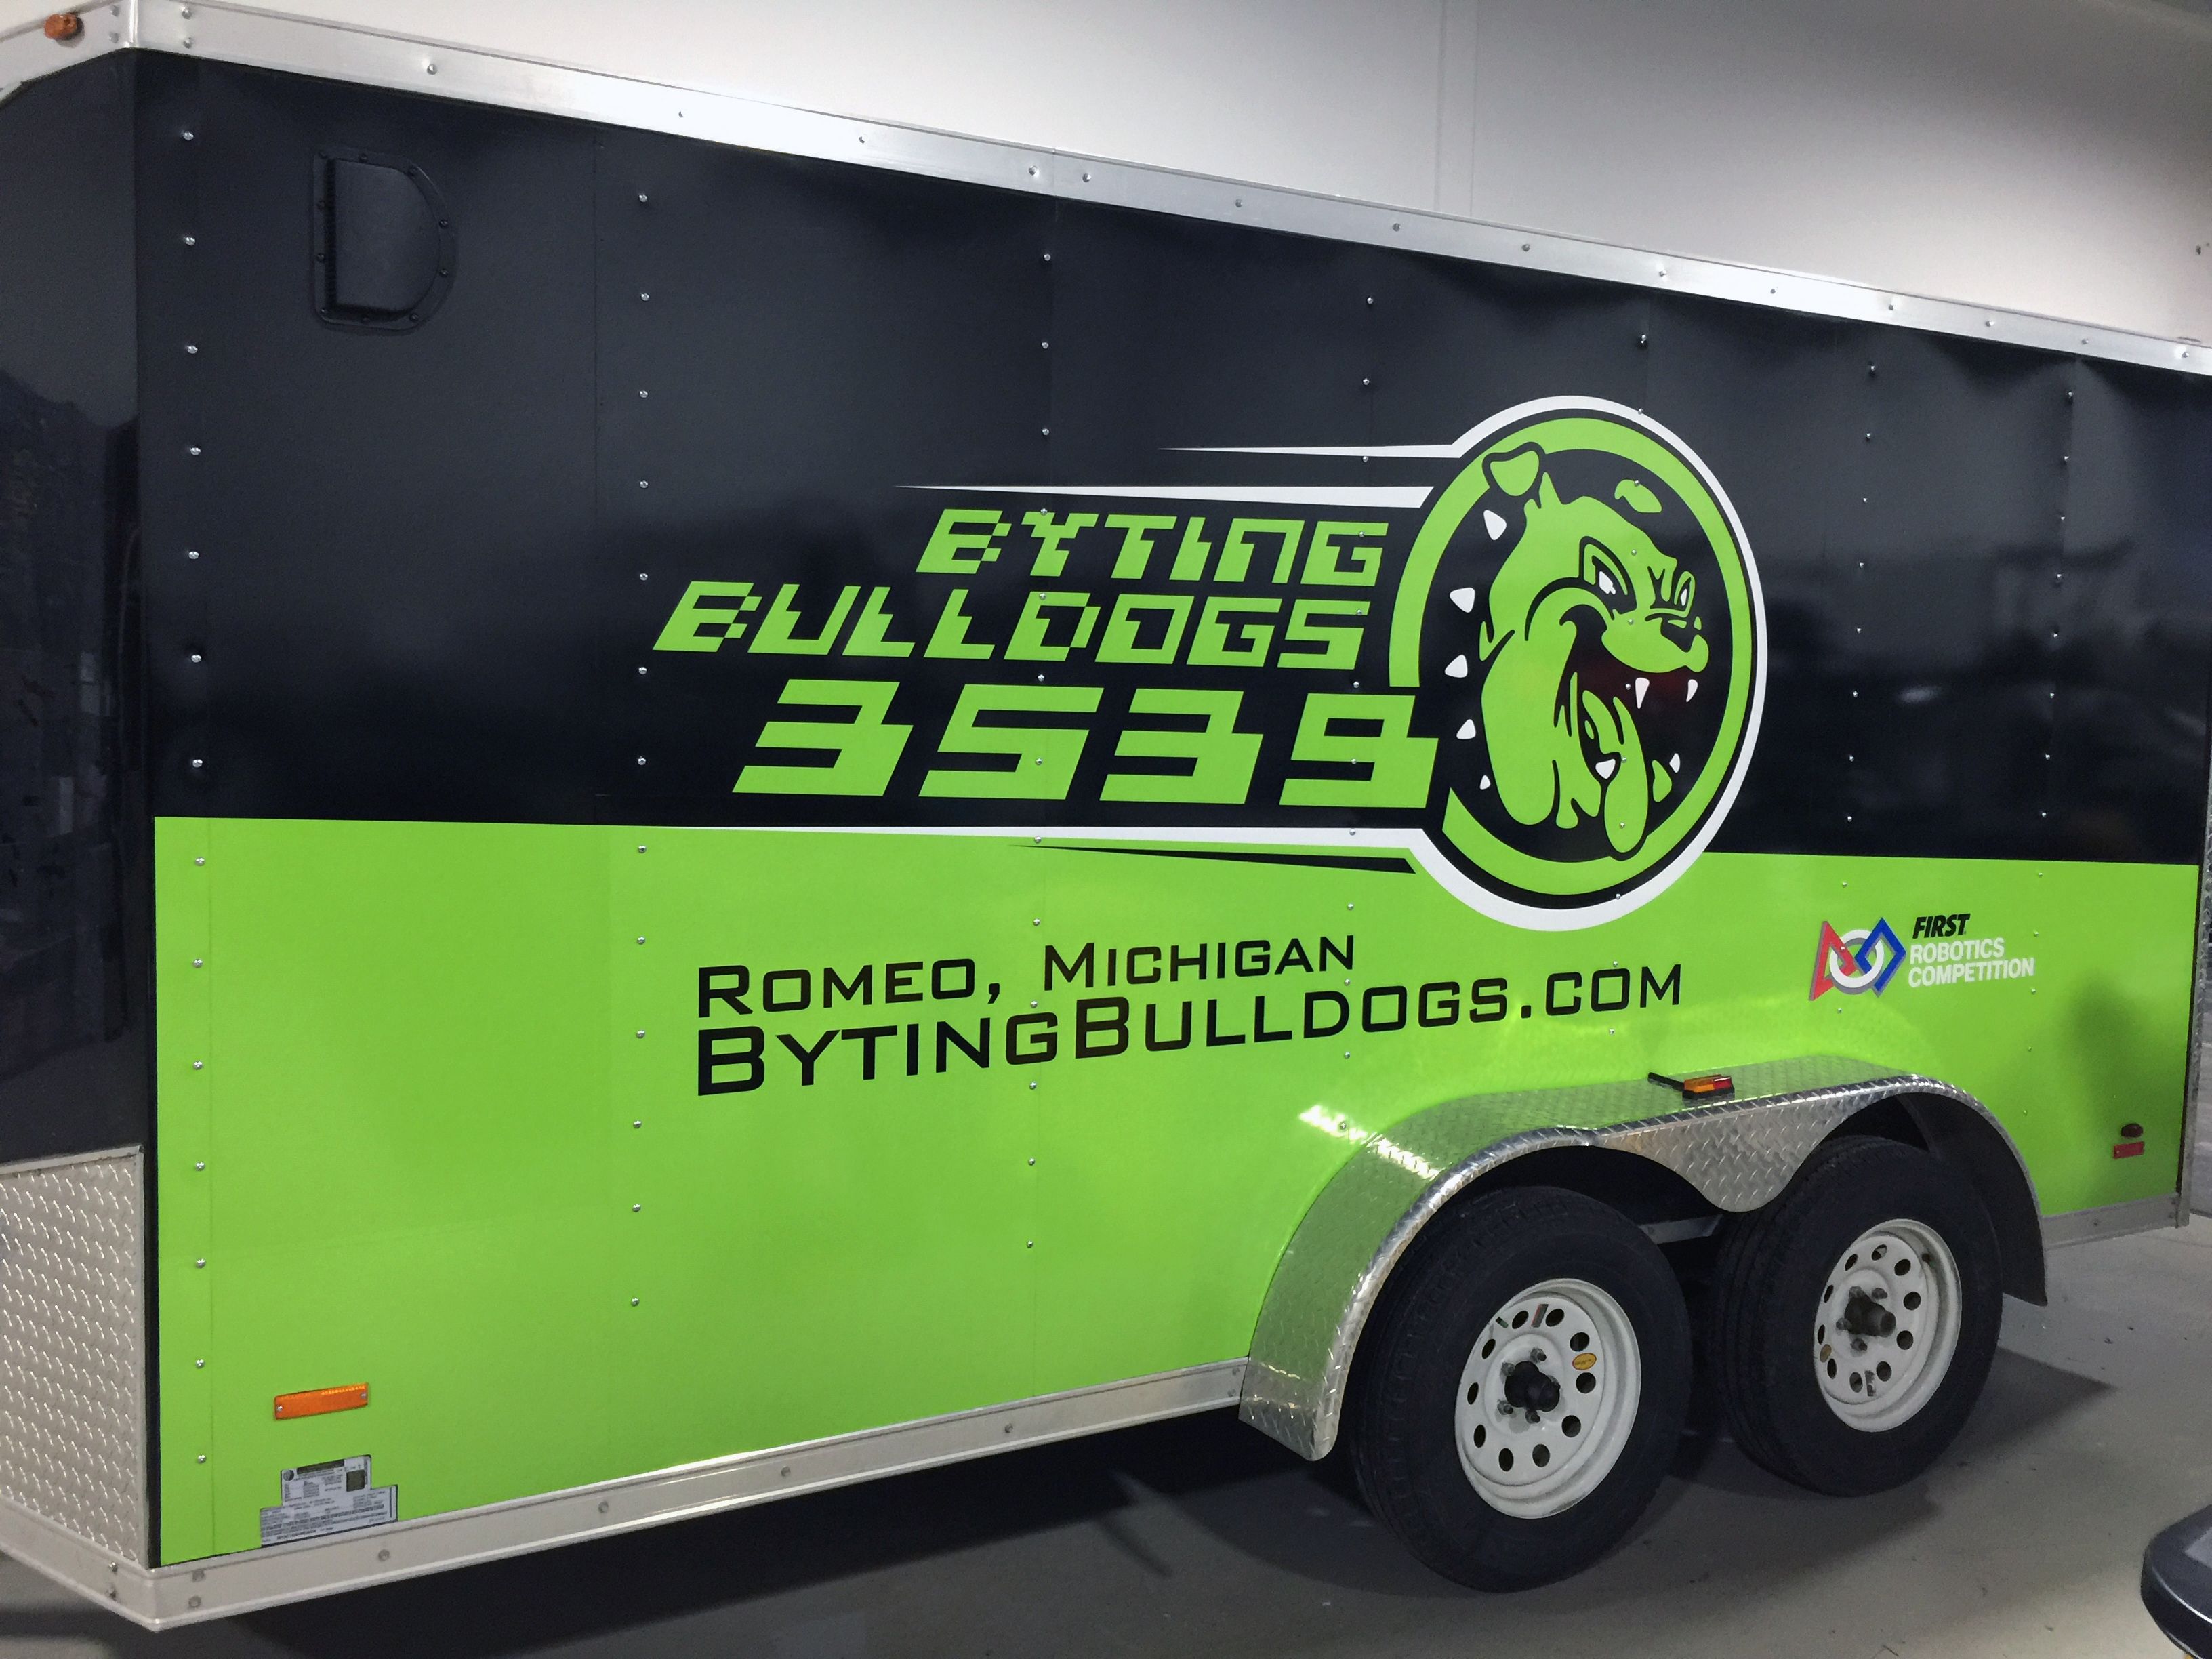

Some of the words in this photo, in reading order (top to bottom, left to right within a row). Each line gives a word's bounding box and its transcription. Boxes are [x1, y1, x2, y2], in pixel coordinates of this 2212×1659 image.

[916, 508, 1389, 587] BYTING
[653, 581, 1371, 670] BULLDOGS
[733, 678, 1439, 808] 3539
[1910, 937, 2005, 964] ROBOTICS
[1912, 913, 1971, 939] FIRST
[1908, 957, 2035, 988] COMPETITION
